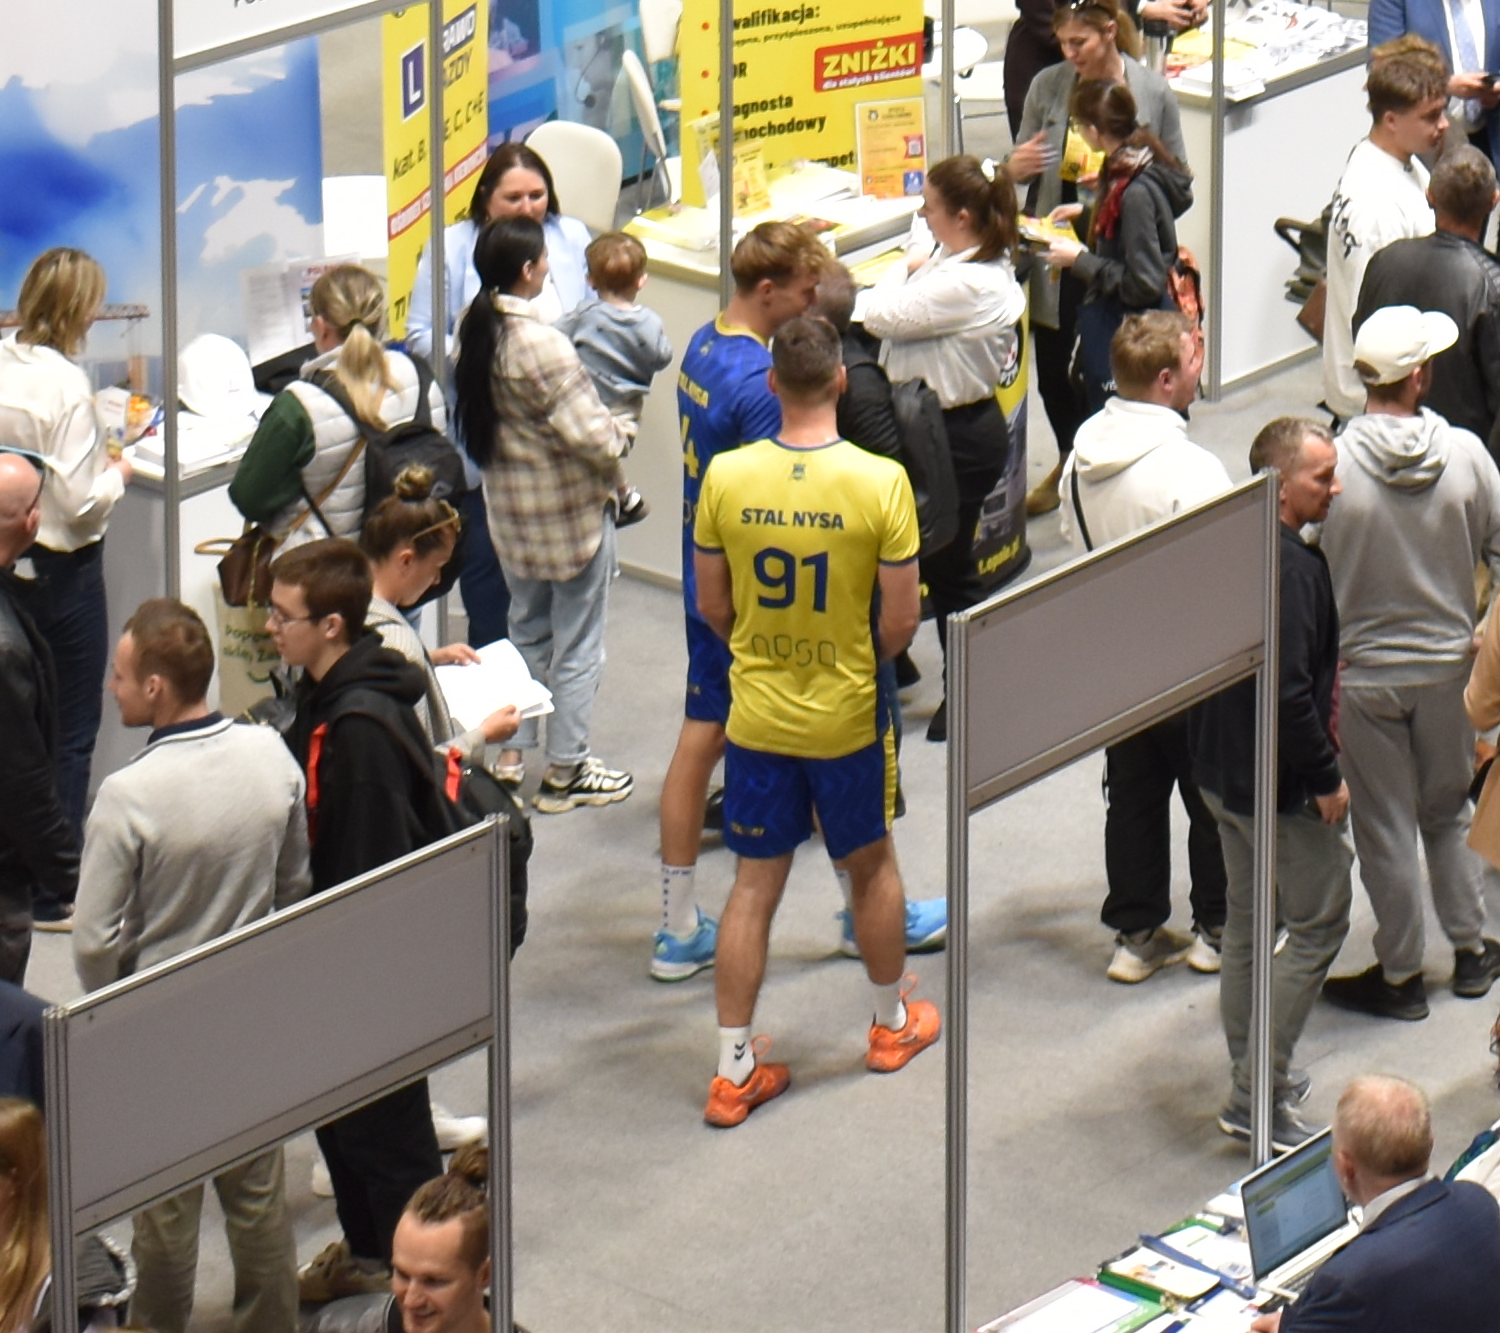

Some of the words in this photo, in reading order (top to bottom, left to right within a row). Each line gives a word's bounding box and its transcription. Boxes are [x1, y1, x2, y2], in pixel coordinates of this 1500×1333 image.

[733, 4, 821, 32] walifikacja:
[822, 39, 917, 79] ZNIŻKI
[407, 60, 421, 105] L
[393, 151, 416, 183] kat.
[741, 507, 788, 527] STAL
[792, 510, 845, 531] NYSA
[753, 546, 829, 614] 91
